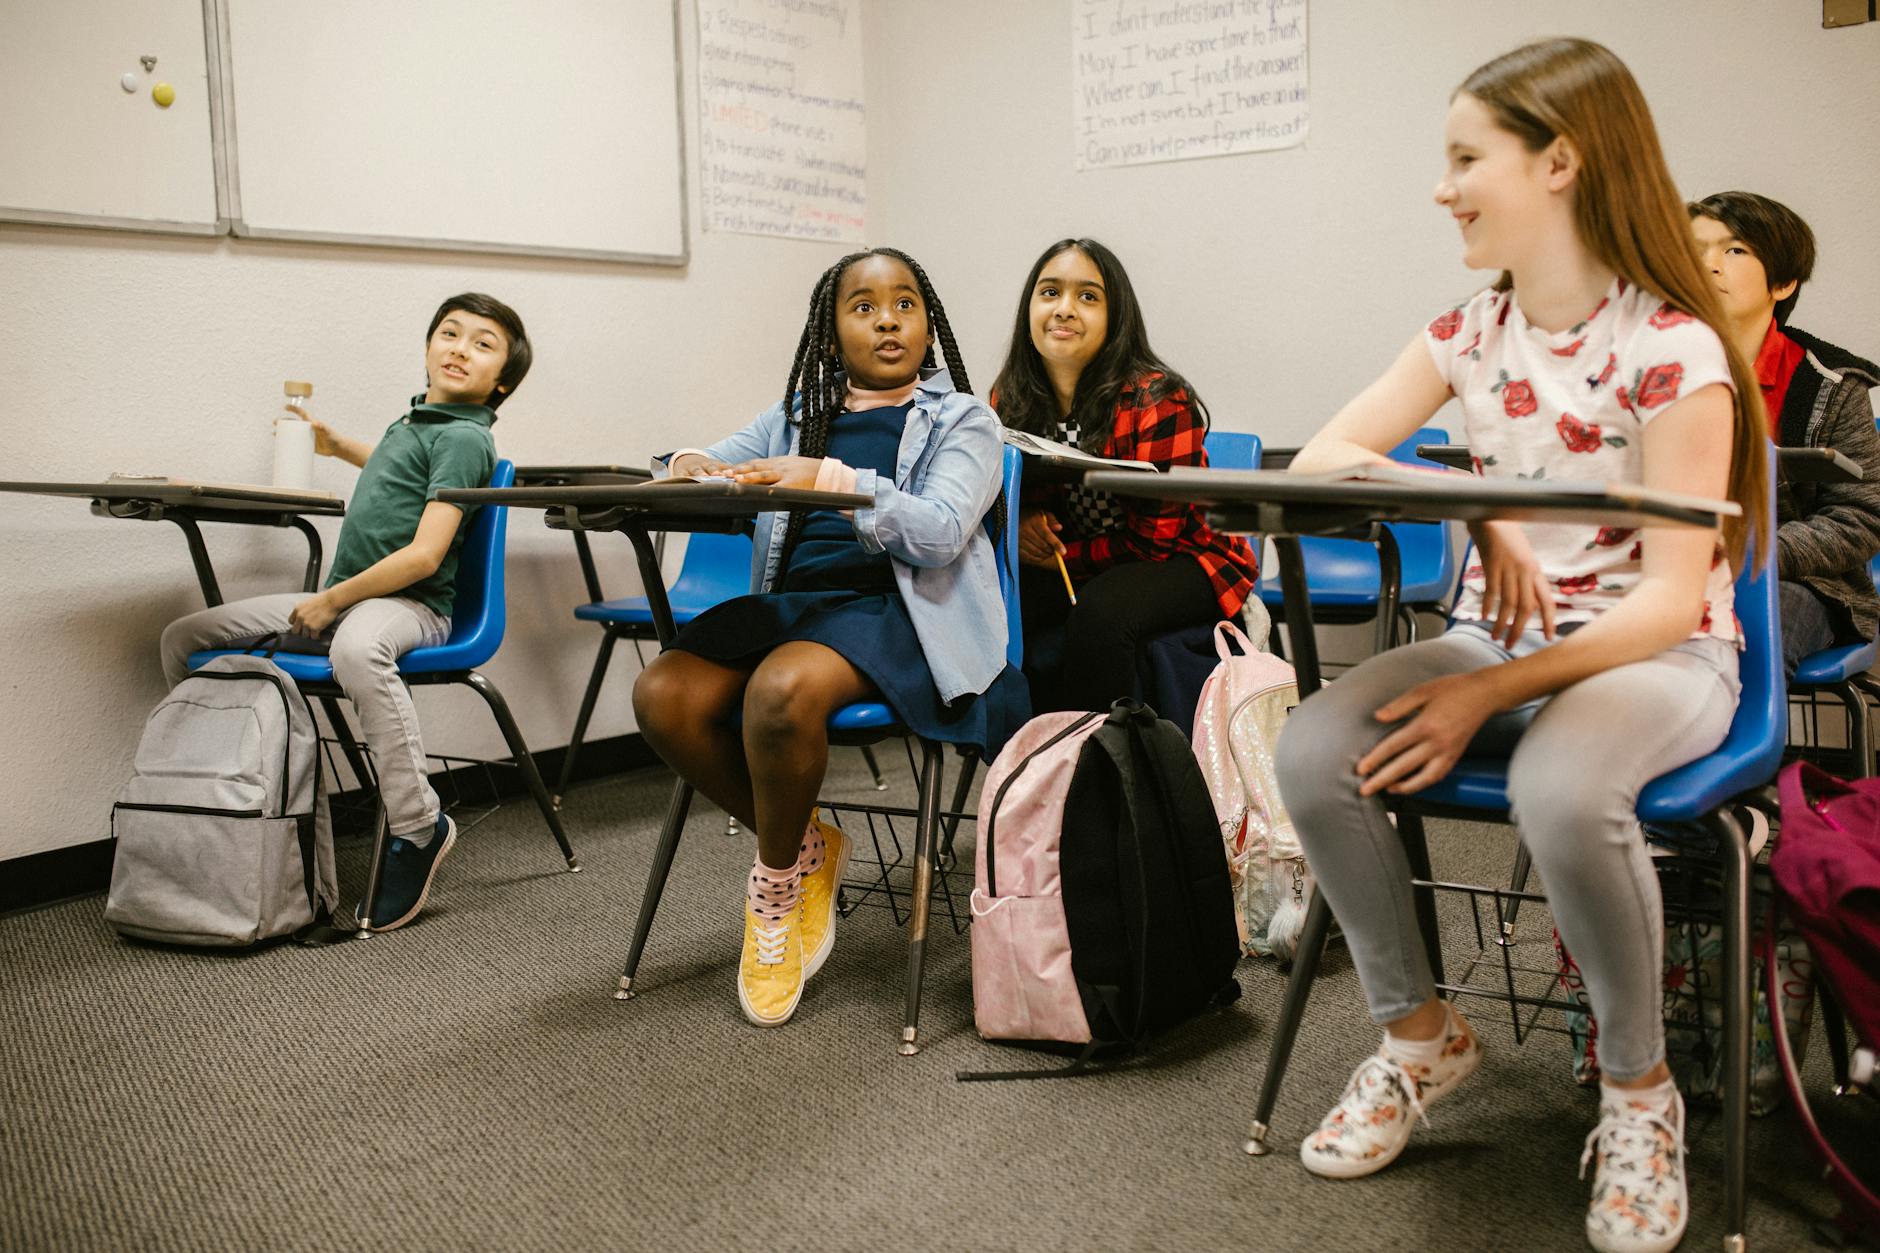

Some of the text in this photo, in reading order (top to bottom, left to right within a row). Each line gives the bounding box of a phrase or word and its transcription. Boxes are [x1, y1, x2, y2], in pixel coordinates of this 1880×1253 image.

[1082, 12, 1099, 40] I
[1079, 52, 1116, 81] May
[1120, 44, 1139, 69] I
[1145, 42, 1183, 62] have
[1184, 37, 1217, 56] some
[1218, 26, 1249, 48] time
[1252, 24, 1265, 46] to
[1083, 82, 1135, 108] Where
[1167, 70, 1186, 96] I
[1189, 58, 1231, 97] find
[1232, 55, 1254, 80] the
[1121, 108, 1146, 126] not
[1187, 98, 1213, 119] but
[1217, 91, 1234, 115] I
[1236, 90, 1271, 108] have
[1085, 139, 1119, 164] Can
[1121, 140, 1148, 162] you
[1150, 133, 1185, 157] help
